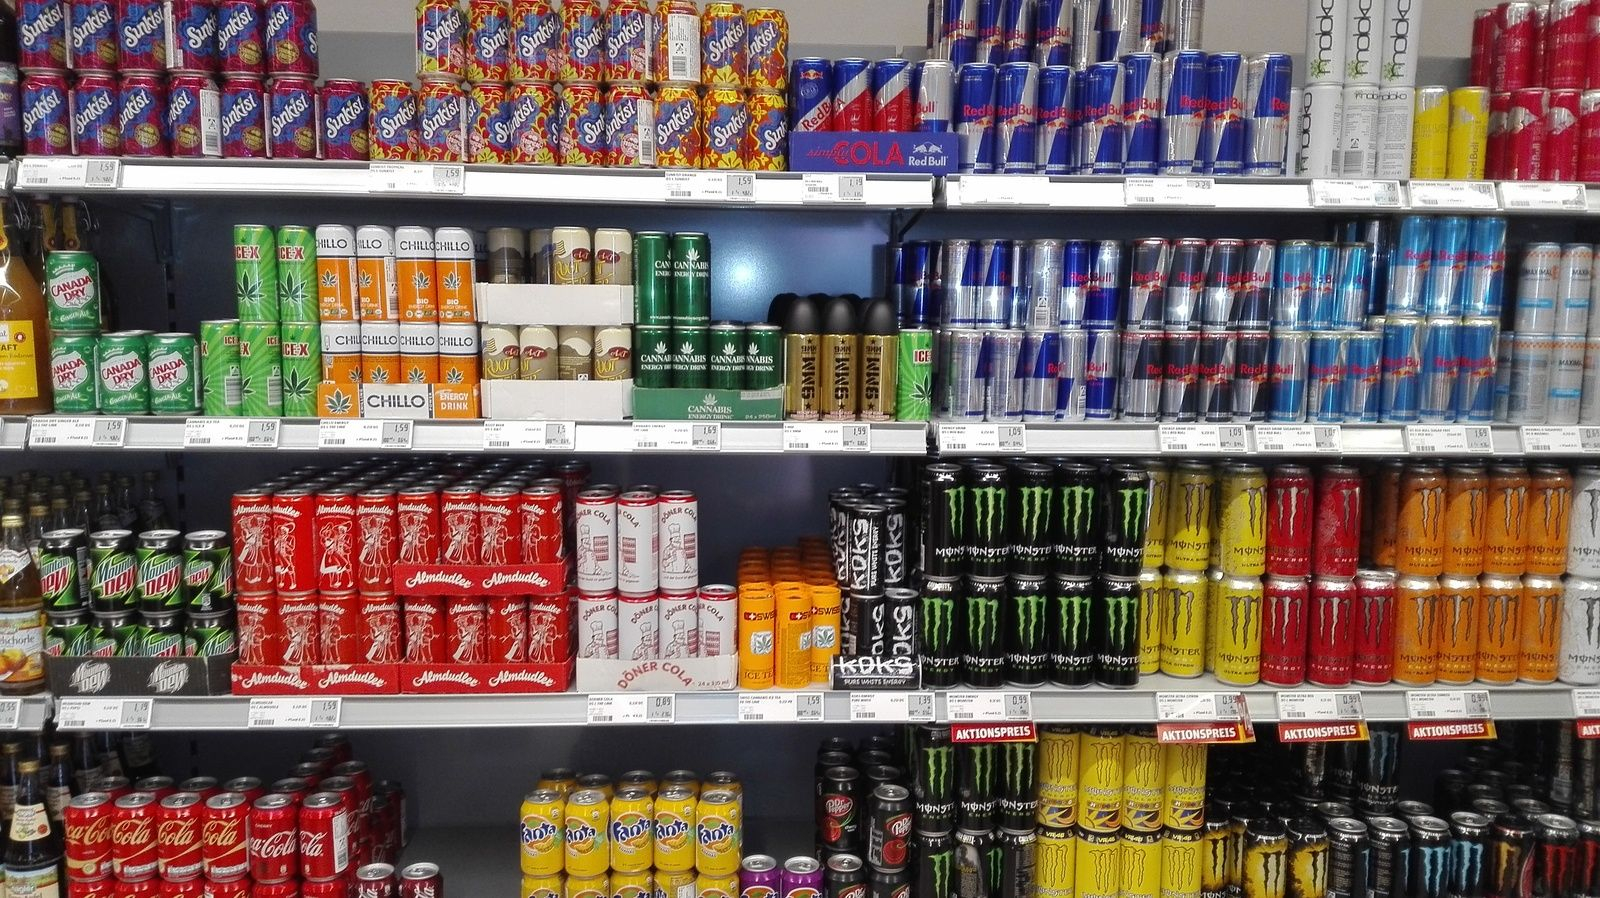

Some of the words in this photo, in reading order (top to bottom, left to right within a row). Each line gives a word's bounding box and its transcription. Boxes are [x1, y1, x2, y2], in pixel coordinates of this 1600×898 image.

[21, 3, 64, 47] Sunkist
[73, 4, 112, 49] Sunkist
[424, 13, 461, 51] Sunkist
[520, 16, 556, 57] Sunkist
[608, 17, 645, 59] Sunkist
[709, 20, 746, 61] Sunkist
[23, 90, 62, 134] Sunkist
[76, 90, 112, 135] Sunkist
[222, 90, 258, 137] Sunkist
[271, 90, 310, 138] Sunkist
[326, 95, 365, 140] Sunkist
[422, 99, 460, 140] Sunkist
[657, 102, 694, 146] Sunkist
[834, 141, 904, 166] COLA
[909, 156, 927, 166] Red
[928, 156, 947, 166] Bull
[738, 176, 752, 187] 1,59
[51, 275, 93, 297] CANADA
[63, 287, 87, 303] DRY
[362, 335, 398, 345] CHILLO
[57, 371, 78, 385] DRY
[101, 358, 142, 380] CANADA
[113, 371, 135, 385] DRY
[157, 371, 177, 385] DRY
[367, 394, 425, 408] CHILLO
[439, 392, 469, 401] ENERGY
[440, 402, 468, 411] DRINK
[688, 405, 732, 414] CANNABIS
[395, 424, 409, 433] 1,59
[703, 426, 717, 435] 1,69
[853, 427, 866, 436] 1,99
[1229, 428, 1242, 437] 1,09
[317, 504, 355, 516] Almdudler
[594, 510, 611, 526] COLA
[622, 510, 640, 528] COLA
[661, 507, 683, 525] DÖNER
[850, 518, 870, 590] KOKS
[885, 512, 904, 584] KOKS
[406, 571, 475, 589] Almdudler
[482, 570, 551, 588] Almdudler
[583, 605, 606, 621] DÖNER
[664, 604, 687, 621] DÖNER
[706, 605, 724, 622] COLA
[839, 655, 914, 675] KOKS
[242, 672, 311, 690] Almdudler
[318, 669, 387, 688] Almdudler
[413, 669, 481, 688] Almdudler
[489, 669, 557, 688] Almdudler
[617, 661, 658, 690] DÖNER
[661, 661, 694, 687] COLA
[844, 678, 861, 686] PURE
[861, 678, 882, 686] WHITE
[882, 678, 907, 686] ENERGY
[655, 697, 671, 707] 0,89
[807, 696, 820, 706] 1,59
[1012, 696, 1027, 705] 0,99
[956, 726, 1031, 740] AKTIONSPREIS
[1161, 727, 1237, 741] AKTIONSPREIS
[1283, 724, 1357, 740] AKTIONSPREIS
[1413, 723, 1485, 738] AKTIONSPREIS
[113, 816, 157, 846] Cola
[158, 817, 198, 846] Cola
[613, 819, 651, 843] Fanta
[697, 822, 735, 846] Fanta
